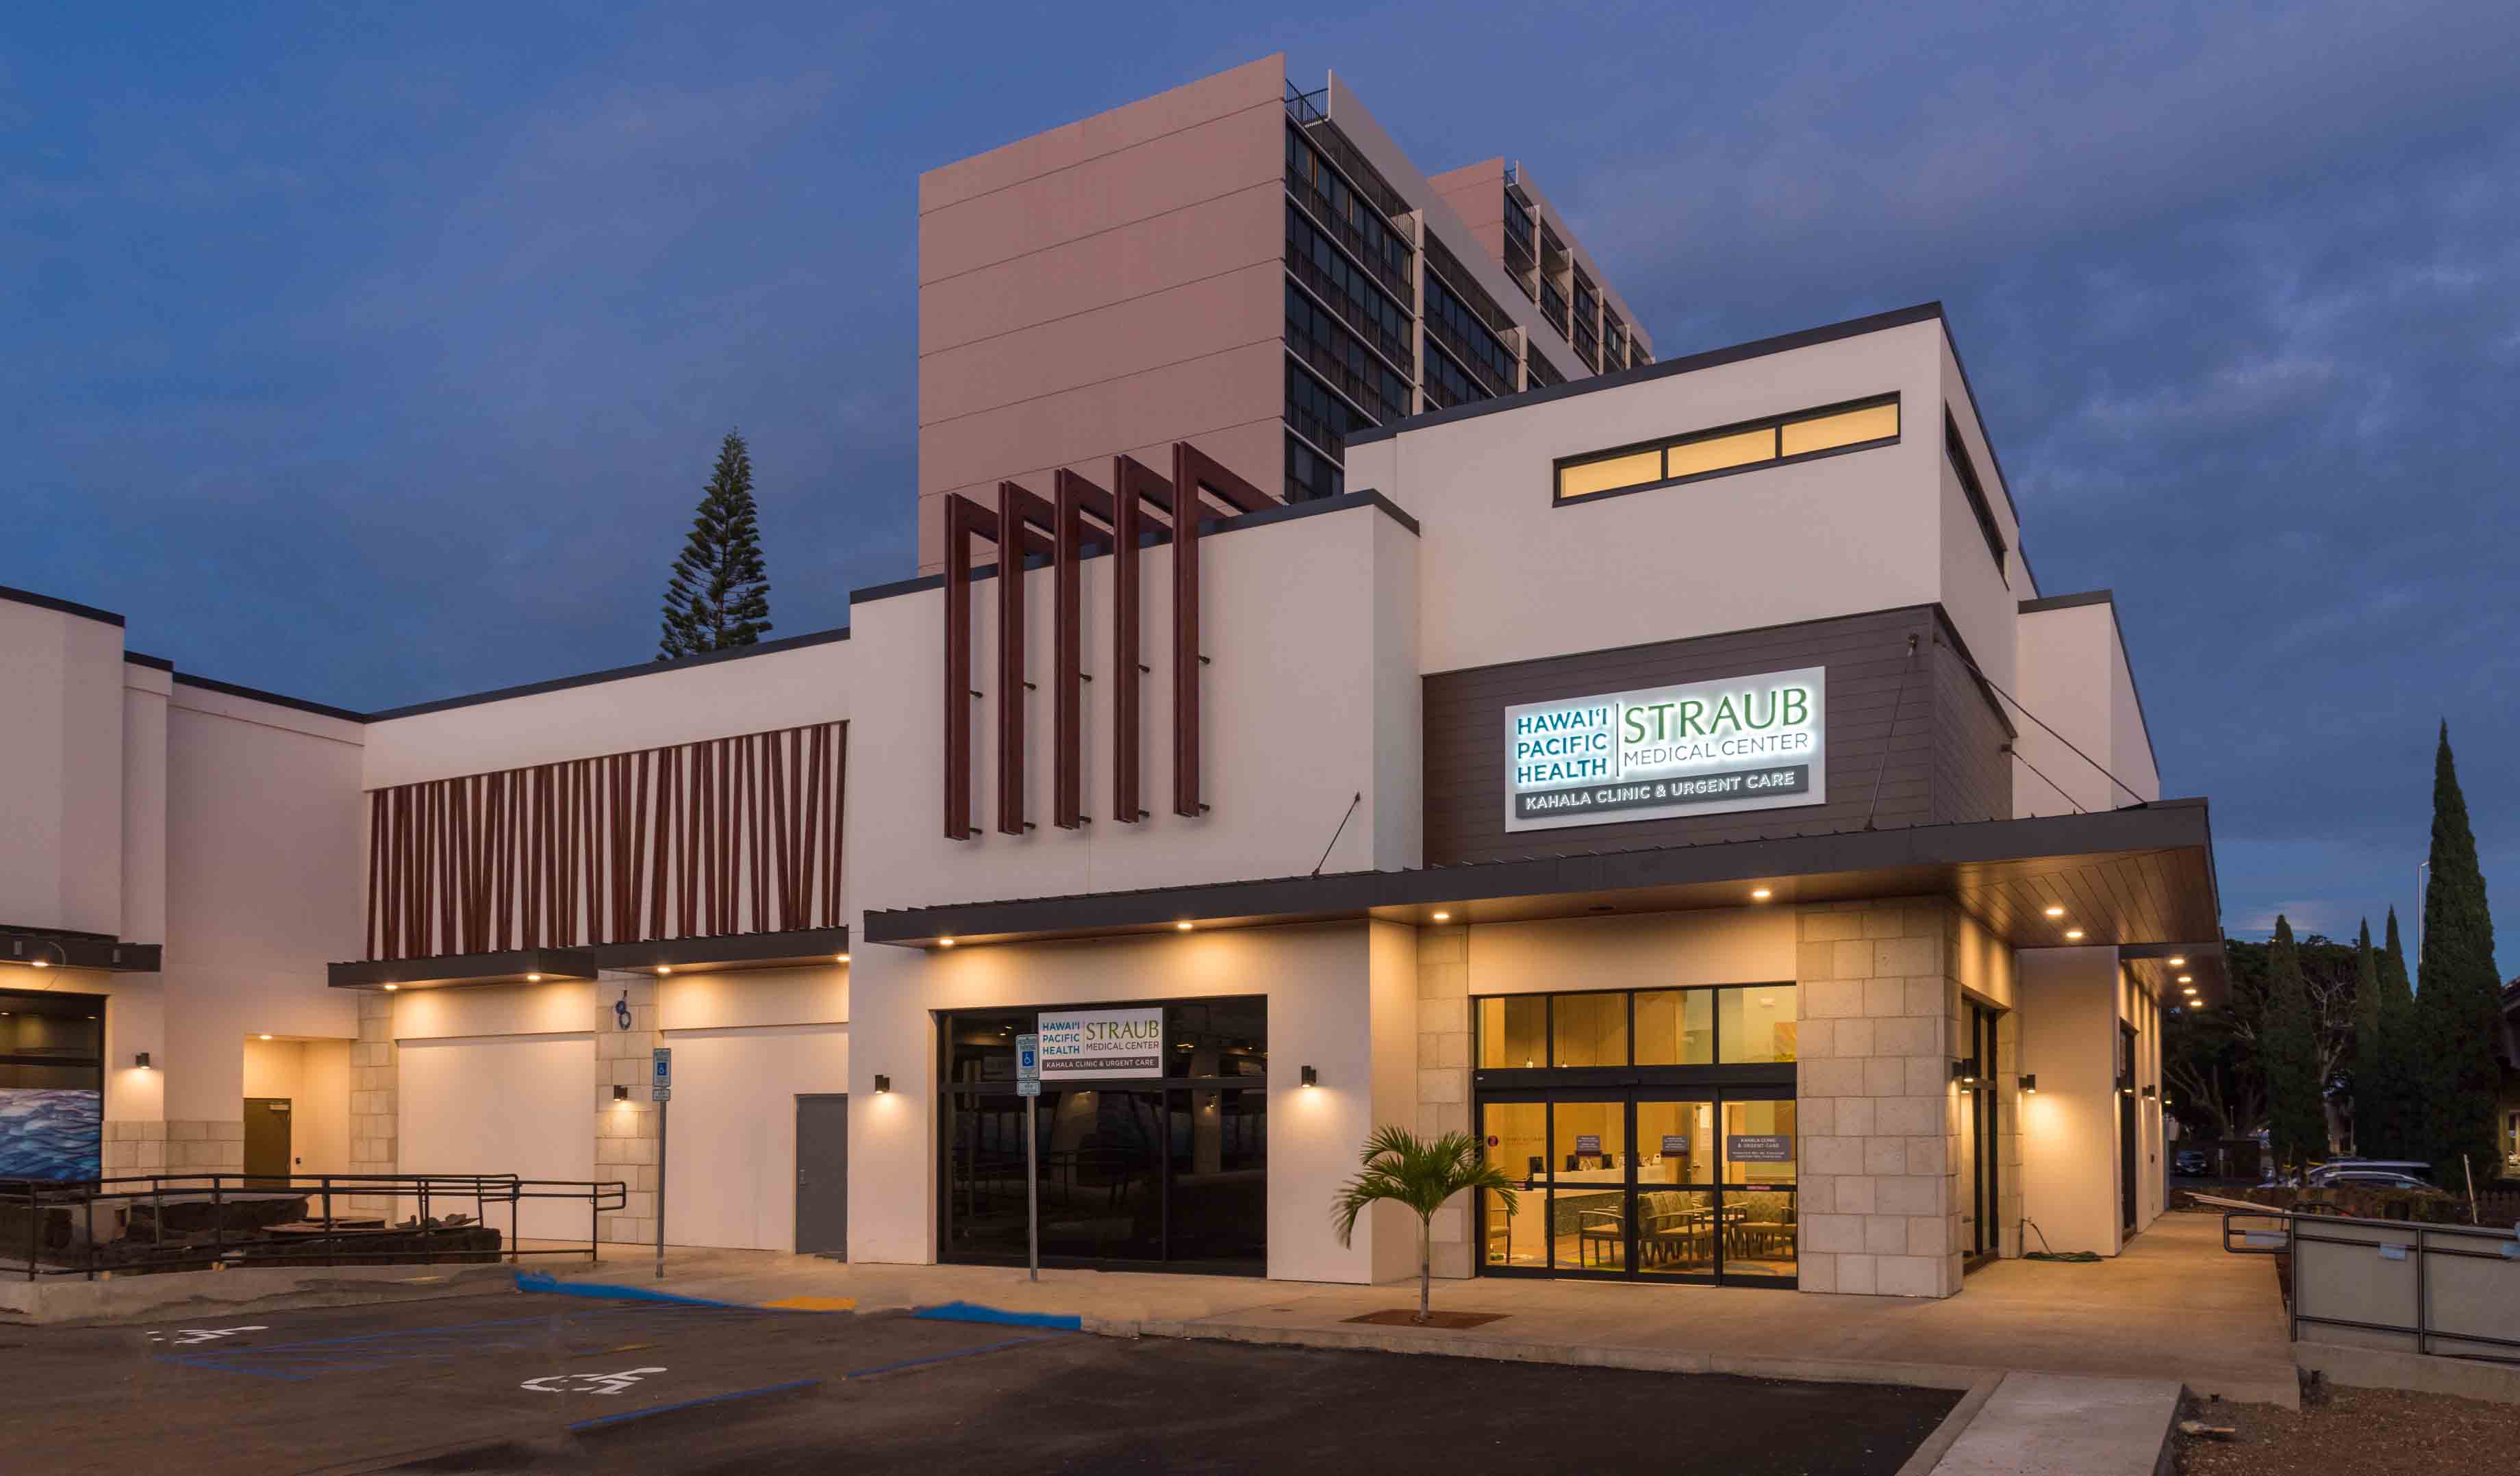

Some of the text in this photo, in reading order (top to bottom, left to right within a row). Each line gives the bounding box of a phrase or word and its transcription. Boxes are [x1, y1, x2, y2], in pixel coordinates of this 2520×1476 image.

[1624, 688, 1809, 744] STRAUB
[1517, 733, 1607, 759] PACIFIC
[1624, 733, 1809, 767] MEDICAL CENTER
[1517, 758, 1607, 783] HEALTH
[1526, 772, 1795, 810] KAHALA CLINIC & URGENT CARE
[1042, 1034, 1080, 1043] PACIFIC
[1086, 1020, 1159, 1041] STRAUB
[1042, 1045, 1080, 1055] HEALTH
[1086, 1041, 1159, 1051] MEDICAL CENTER
